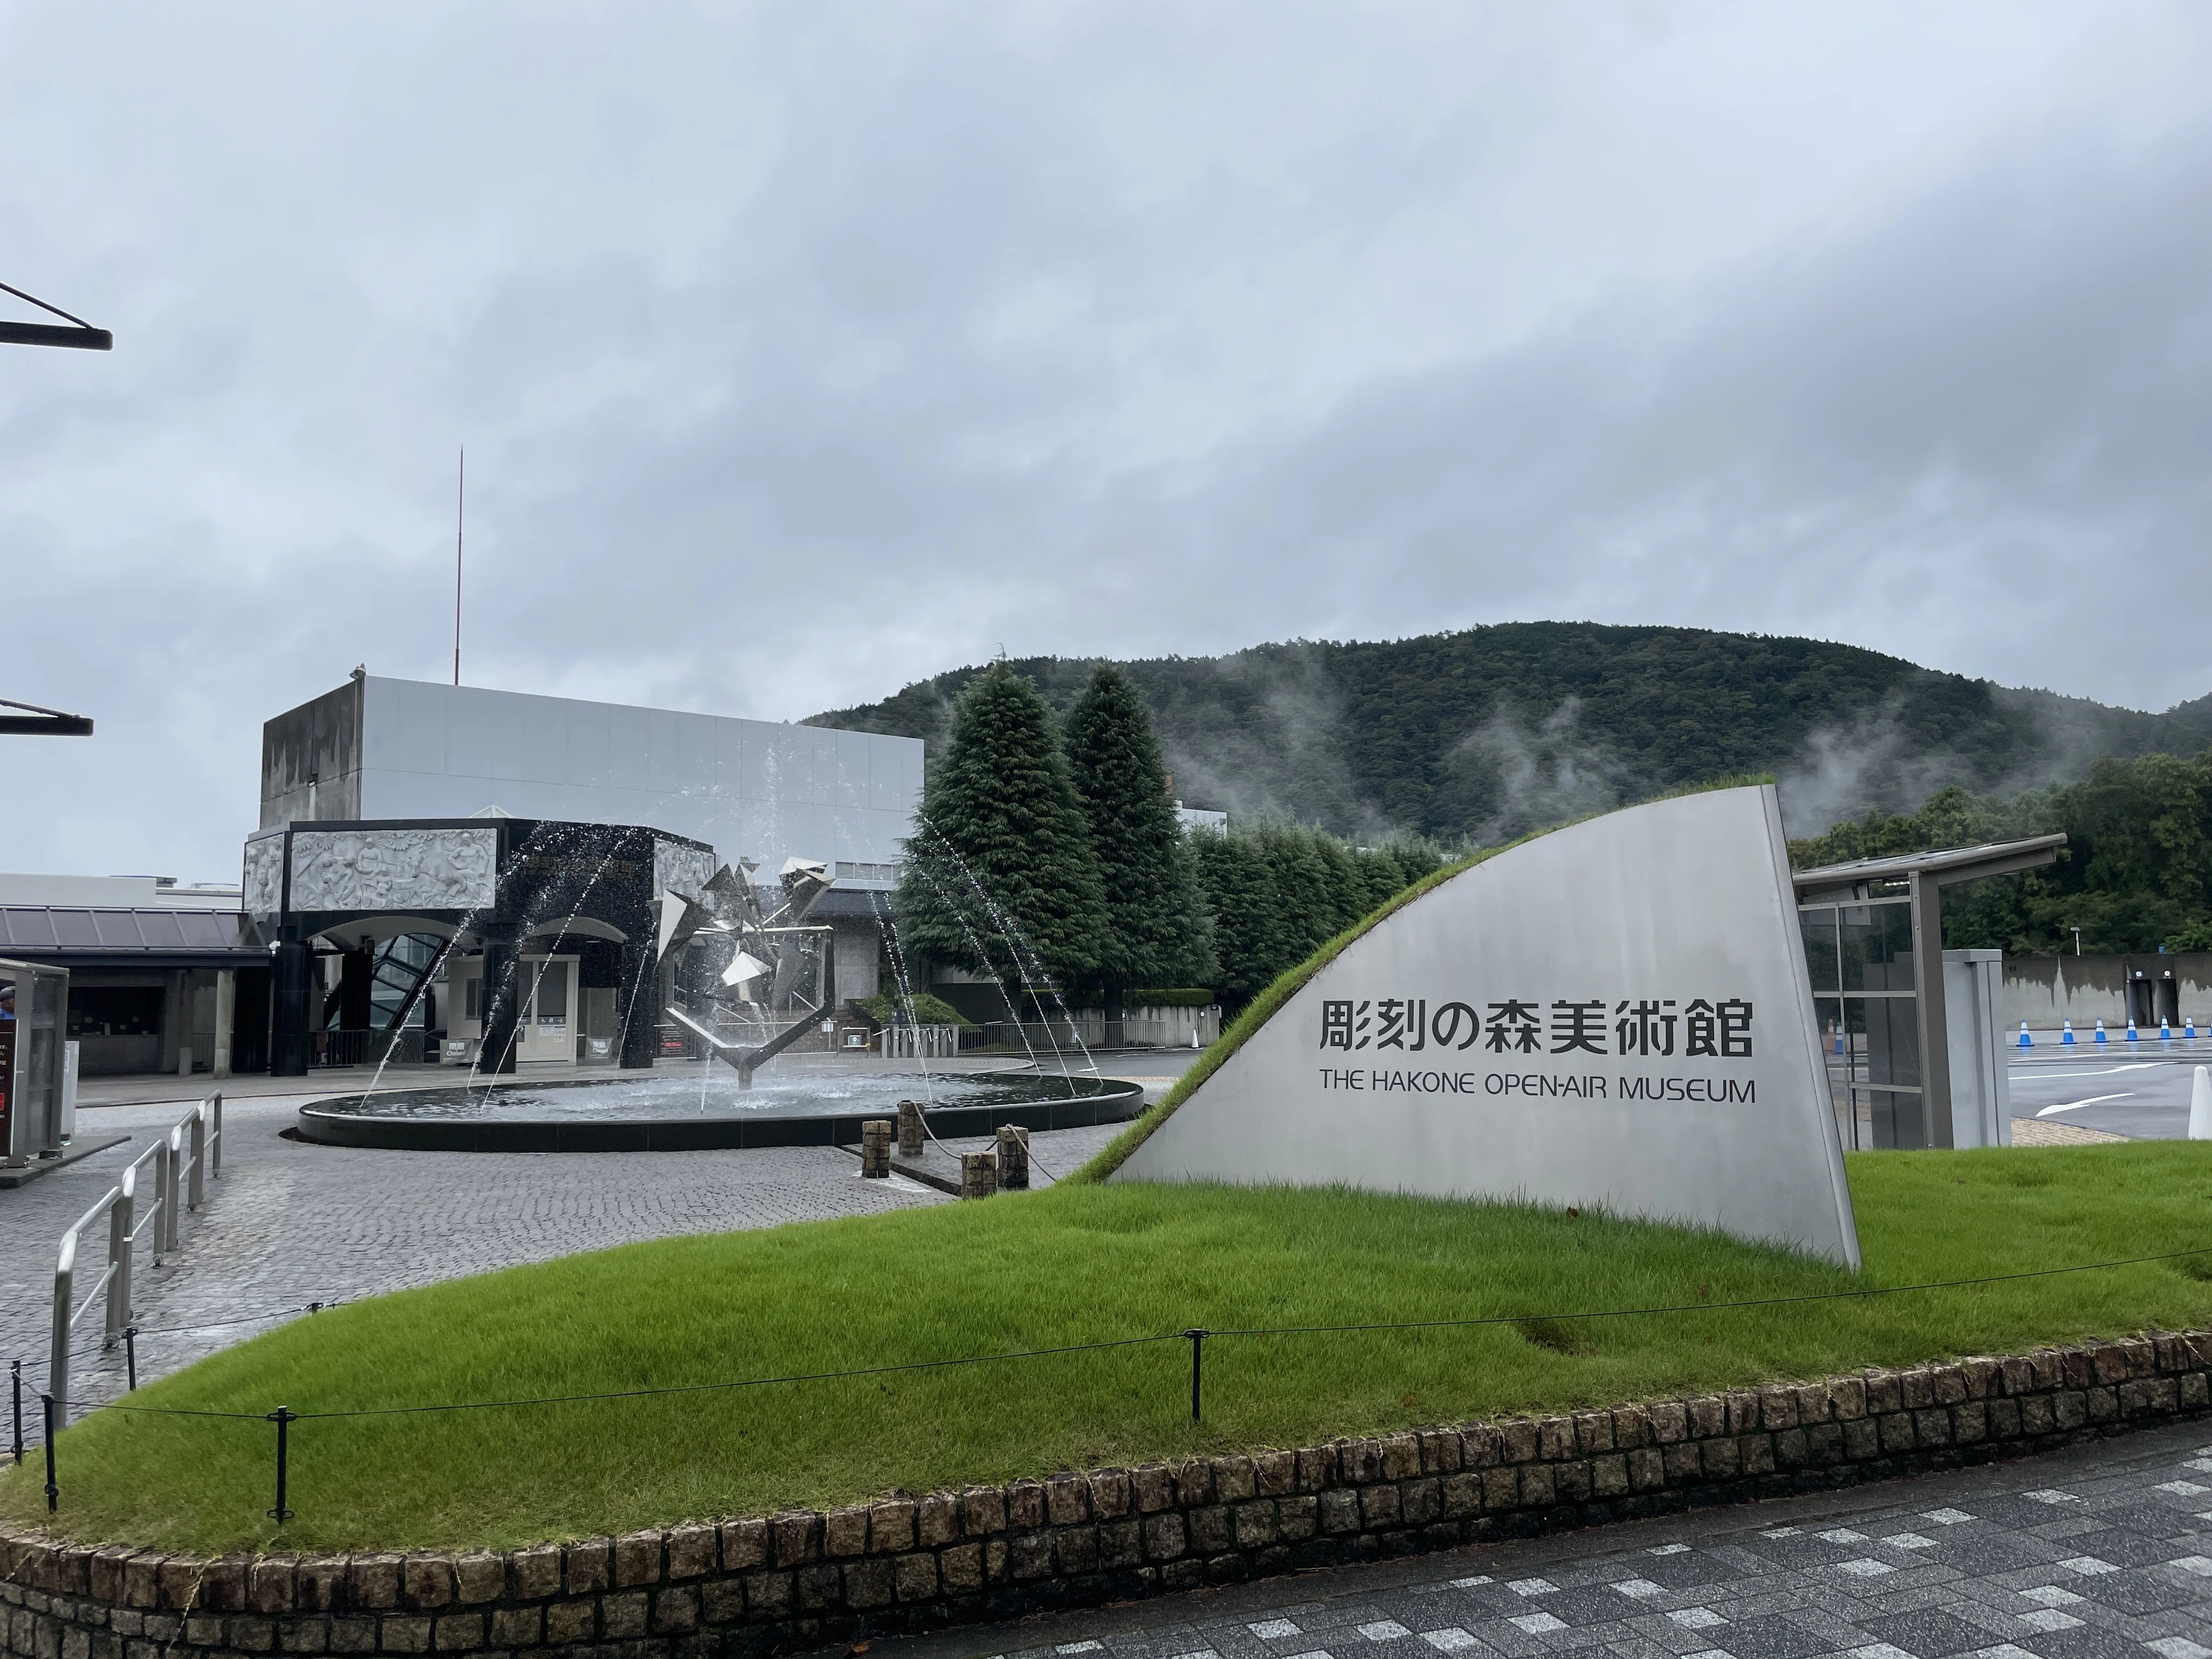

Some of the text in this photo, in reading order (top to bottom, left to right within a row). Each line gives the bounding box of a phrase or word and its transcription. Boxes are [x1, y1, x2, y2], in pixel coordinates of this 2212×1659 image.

[1319, 998, 1753, 1058] 彫刻の森美術館
[1319, 1069, 1756, 1104] THE HAKONE OPEN-AIR MUSEUM
